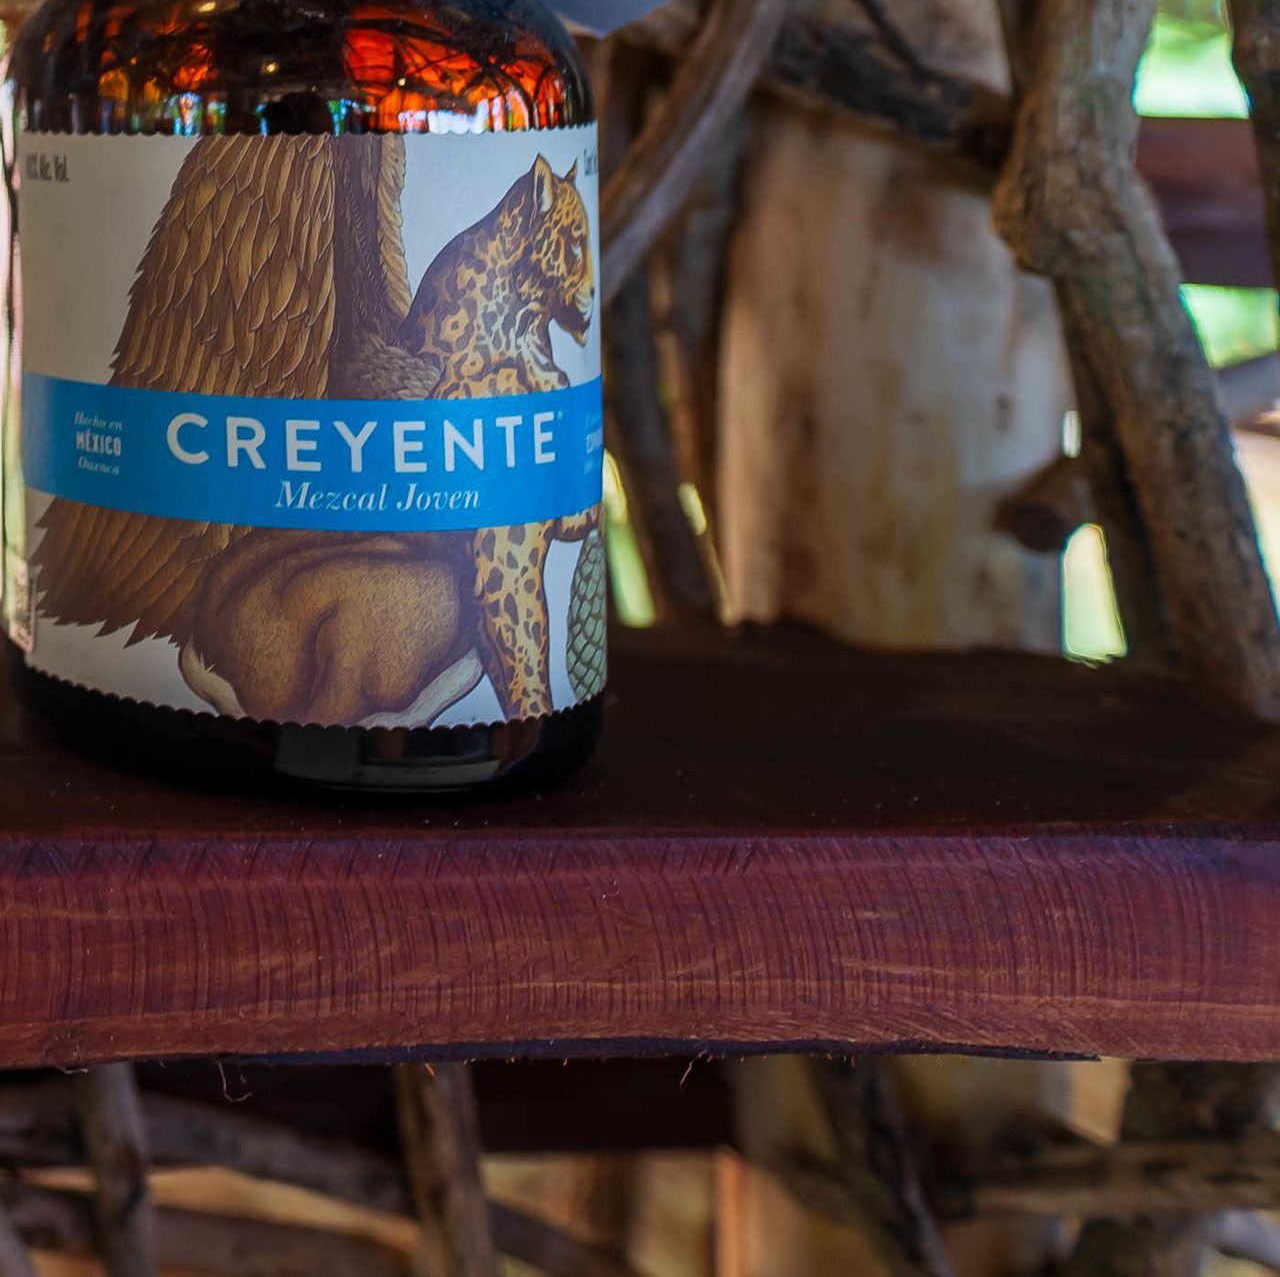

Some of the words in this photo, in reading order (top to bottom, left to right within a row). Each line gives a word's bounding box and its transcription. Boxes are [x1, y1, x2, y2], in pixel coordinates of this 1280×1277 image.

[76, 427, 122, 457] MÉXICO
[166, 410, 556, 474] CREYENTE
[274, 479, 390, 513] Mezcal
[396, 482, 481, 513] Joven
